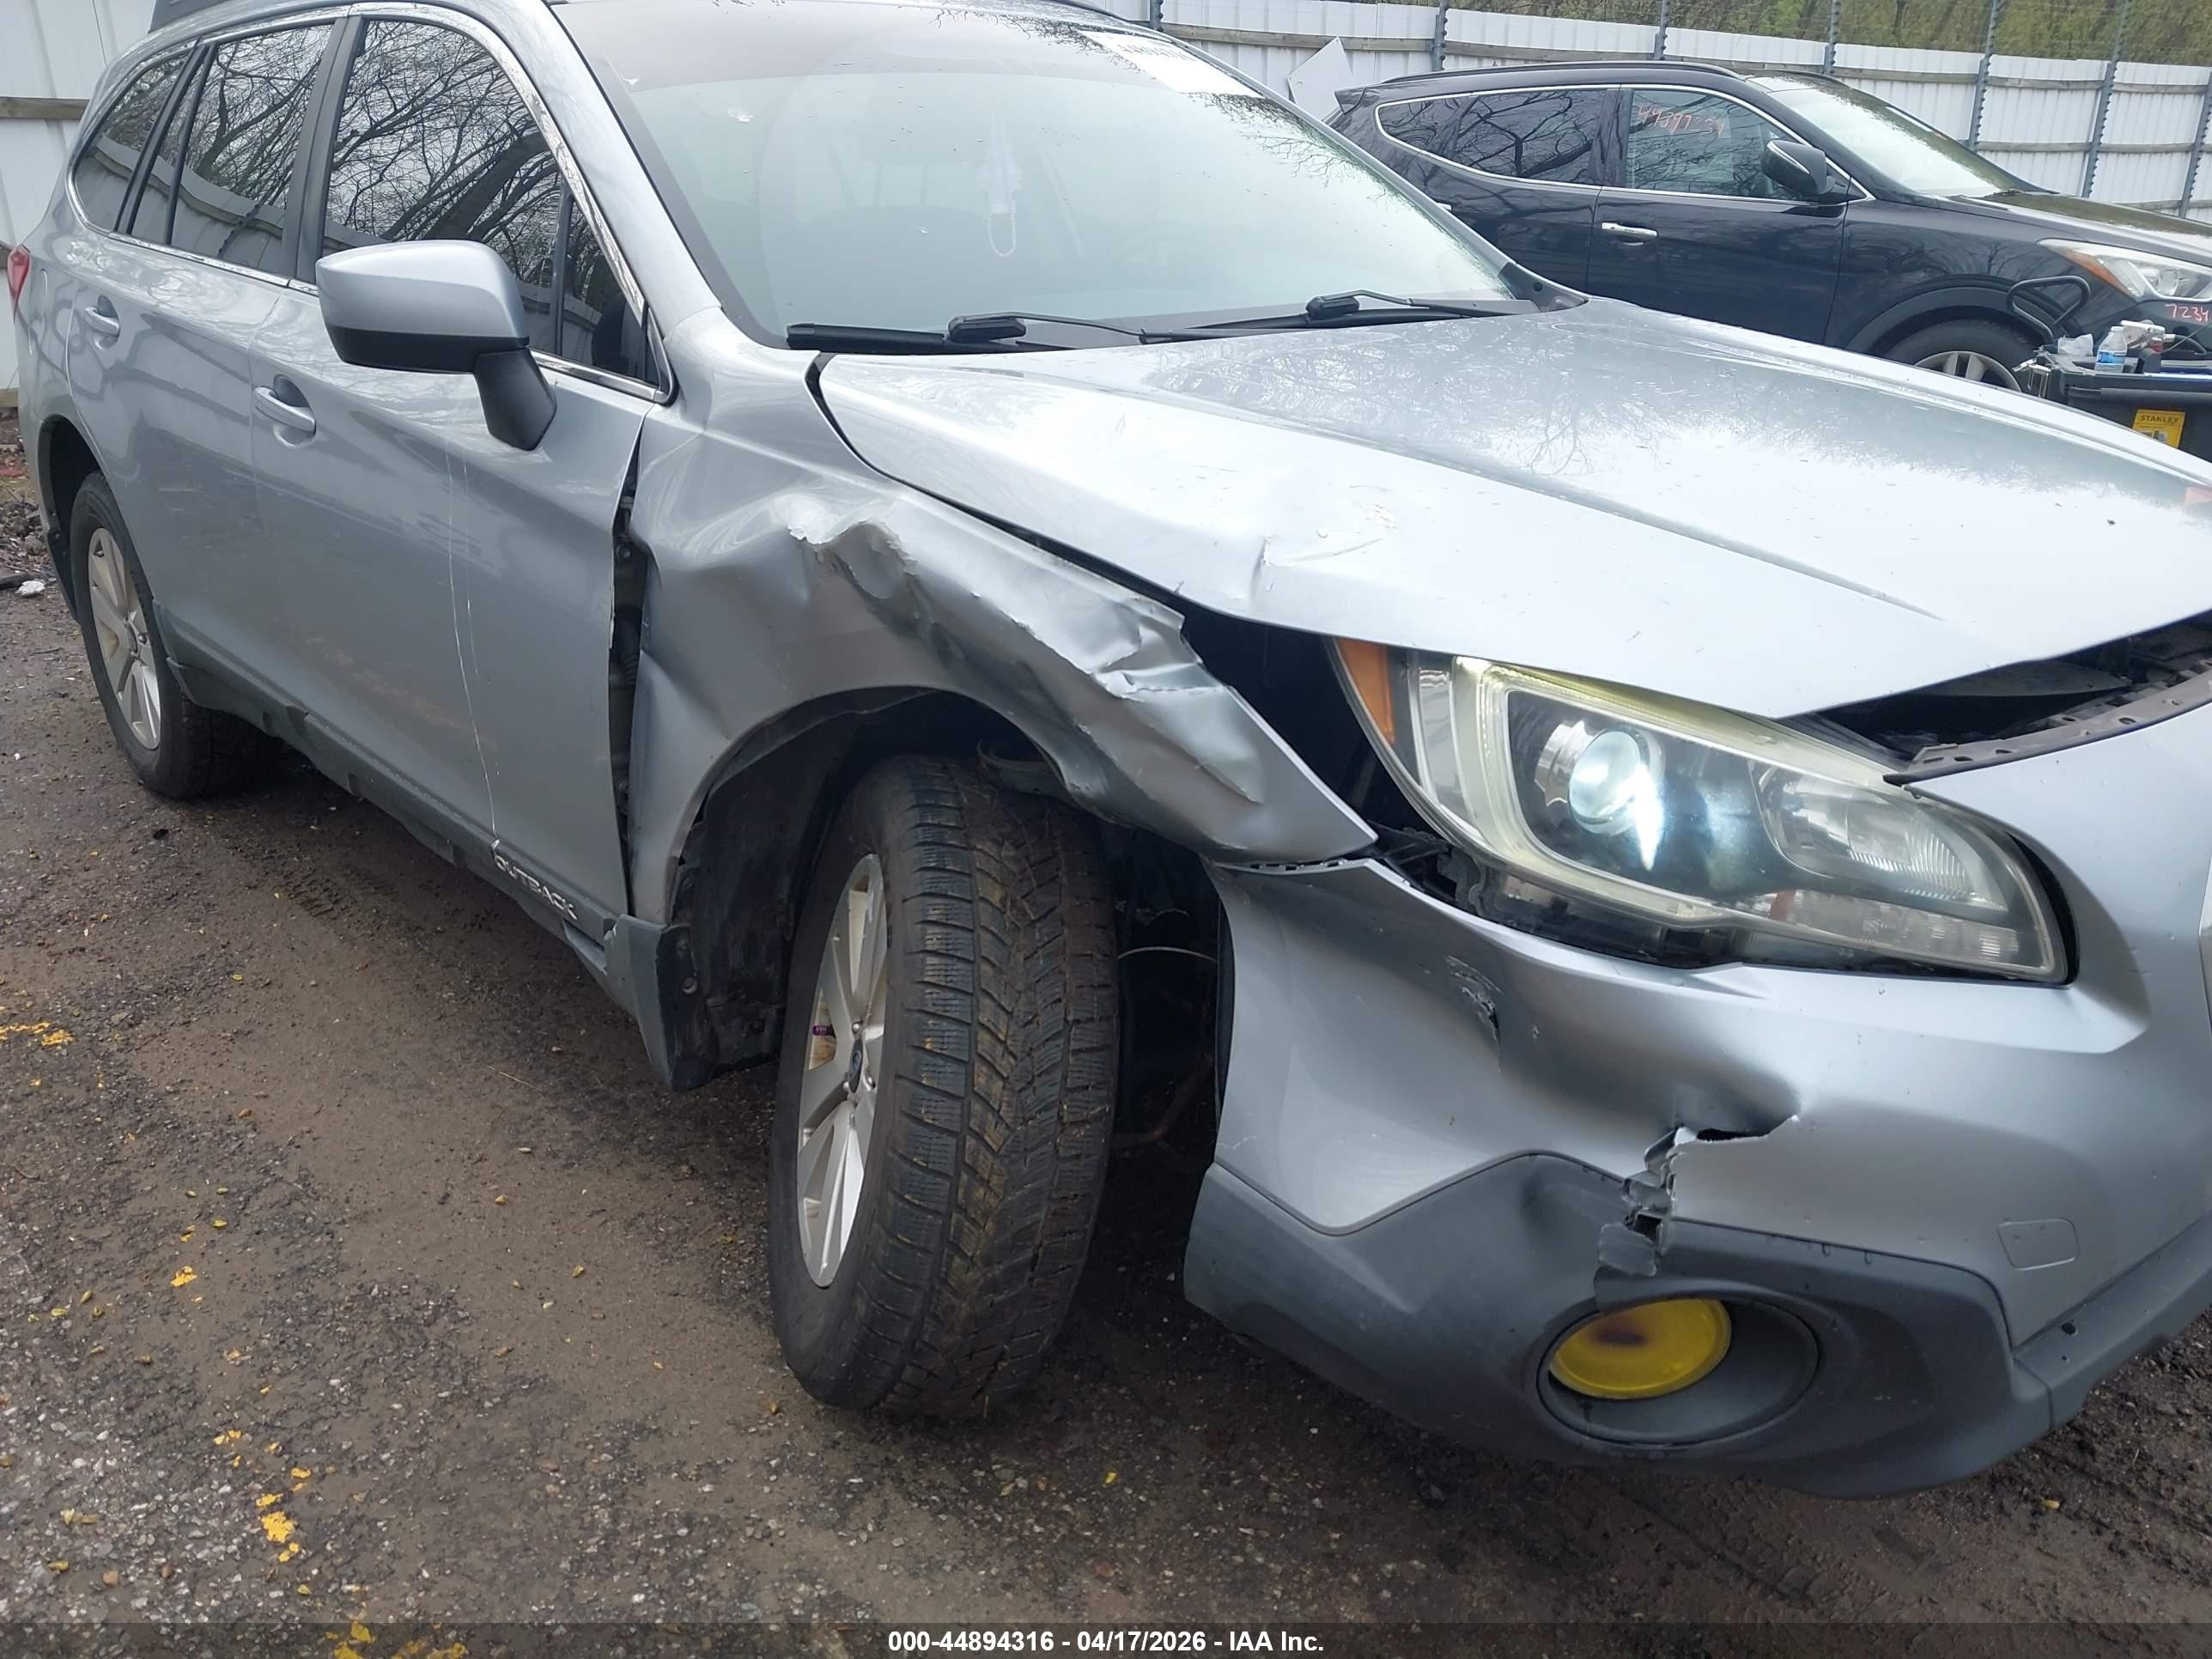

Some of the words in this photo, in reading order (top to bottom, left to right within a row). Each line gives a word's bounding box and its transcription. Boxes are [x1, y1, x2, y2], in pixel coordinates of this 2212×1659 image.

[2164, 303, 2209, 323] 7234
[2141, 415, 2179, 423] STANLEY
[494, 854, 578, 921] OUTBACK
